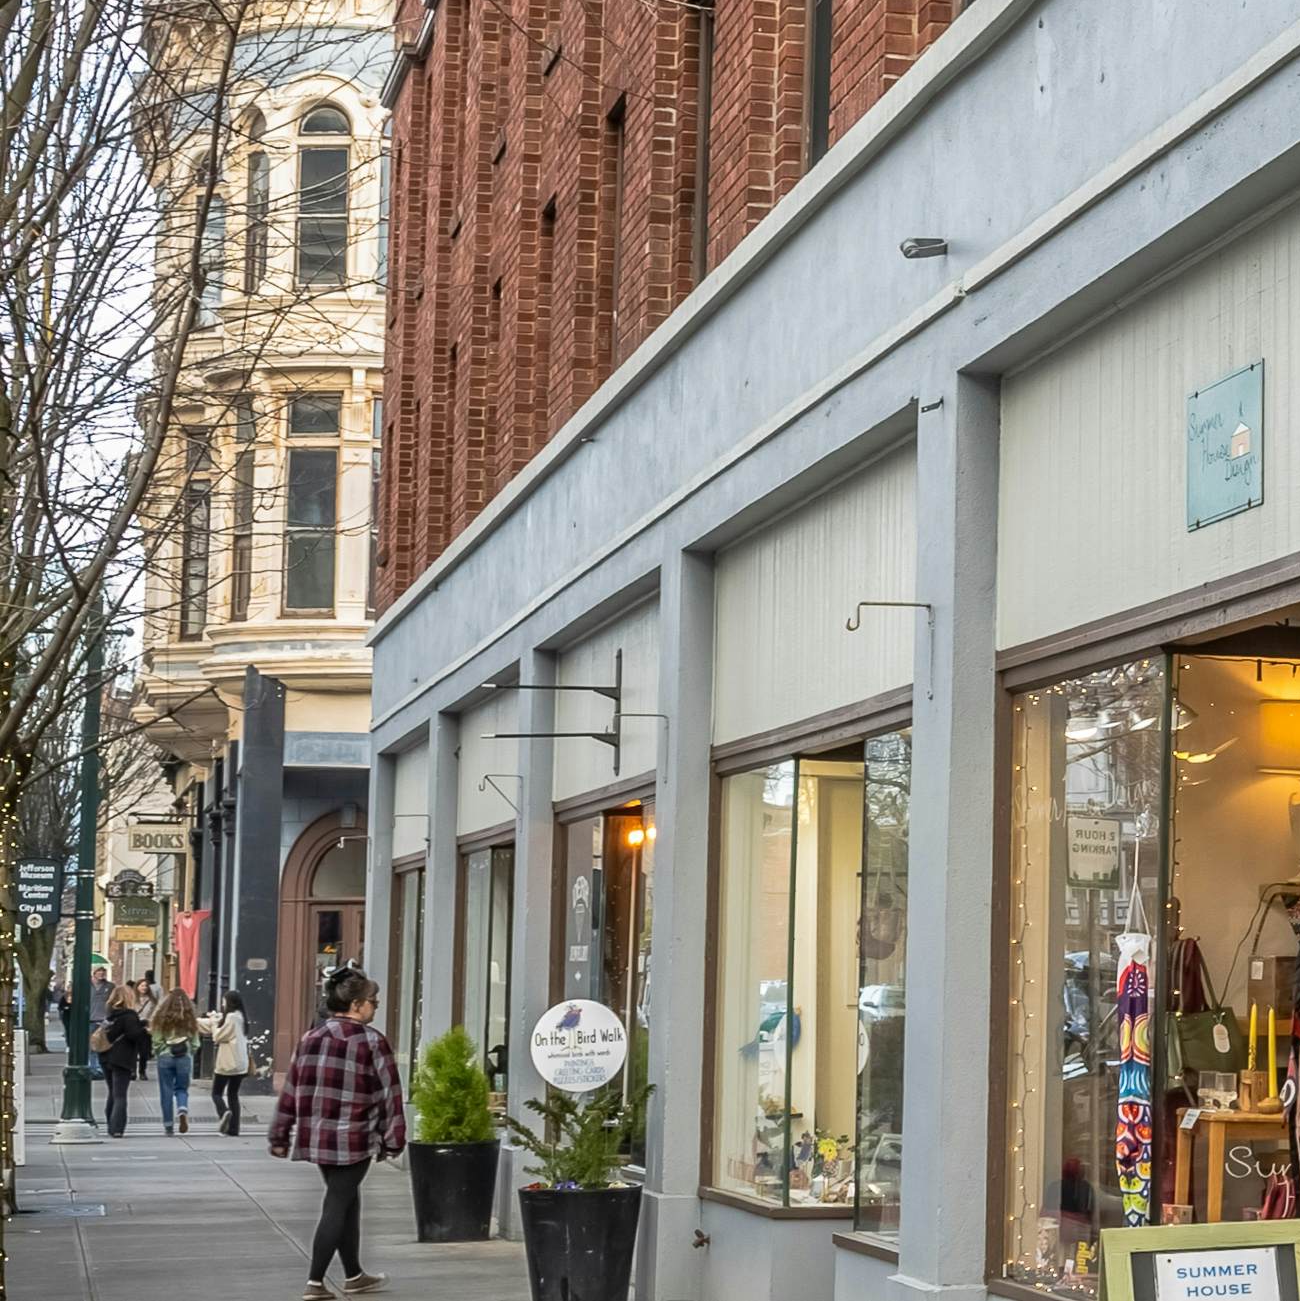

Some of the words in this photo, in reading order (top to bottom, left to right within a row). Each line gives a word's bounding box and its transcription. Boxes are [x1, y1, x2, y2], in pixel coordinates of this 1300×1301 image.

[132, 833, 185, 849] BOOKS
[19, 864, 55, 873] Jefferson
[19, 904, 35, 913] City
[36, 904, 52, 912] Hall
[535, 1032, 548, 1047] On
[550, 1031, 566, 1046] the
[577, 1028, 597, 1044] Bird
[600, 1028, 624, 1043] Walk
[1176, 1264, 1258, 1279] SUMMER
[1187, 1283, 1252, 1298] HOUSE
